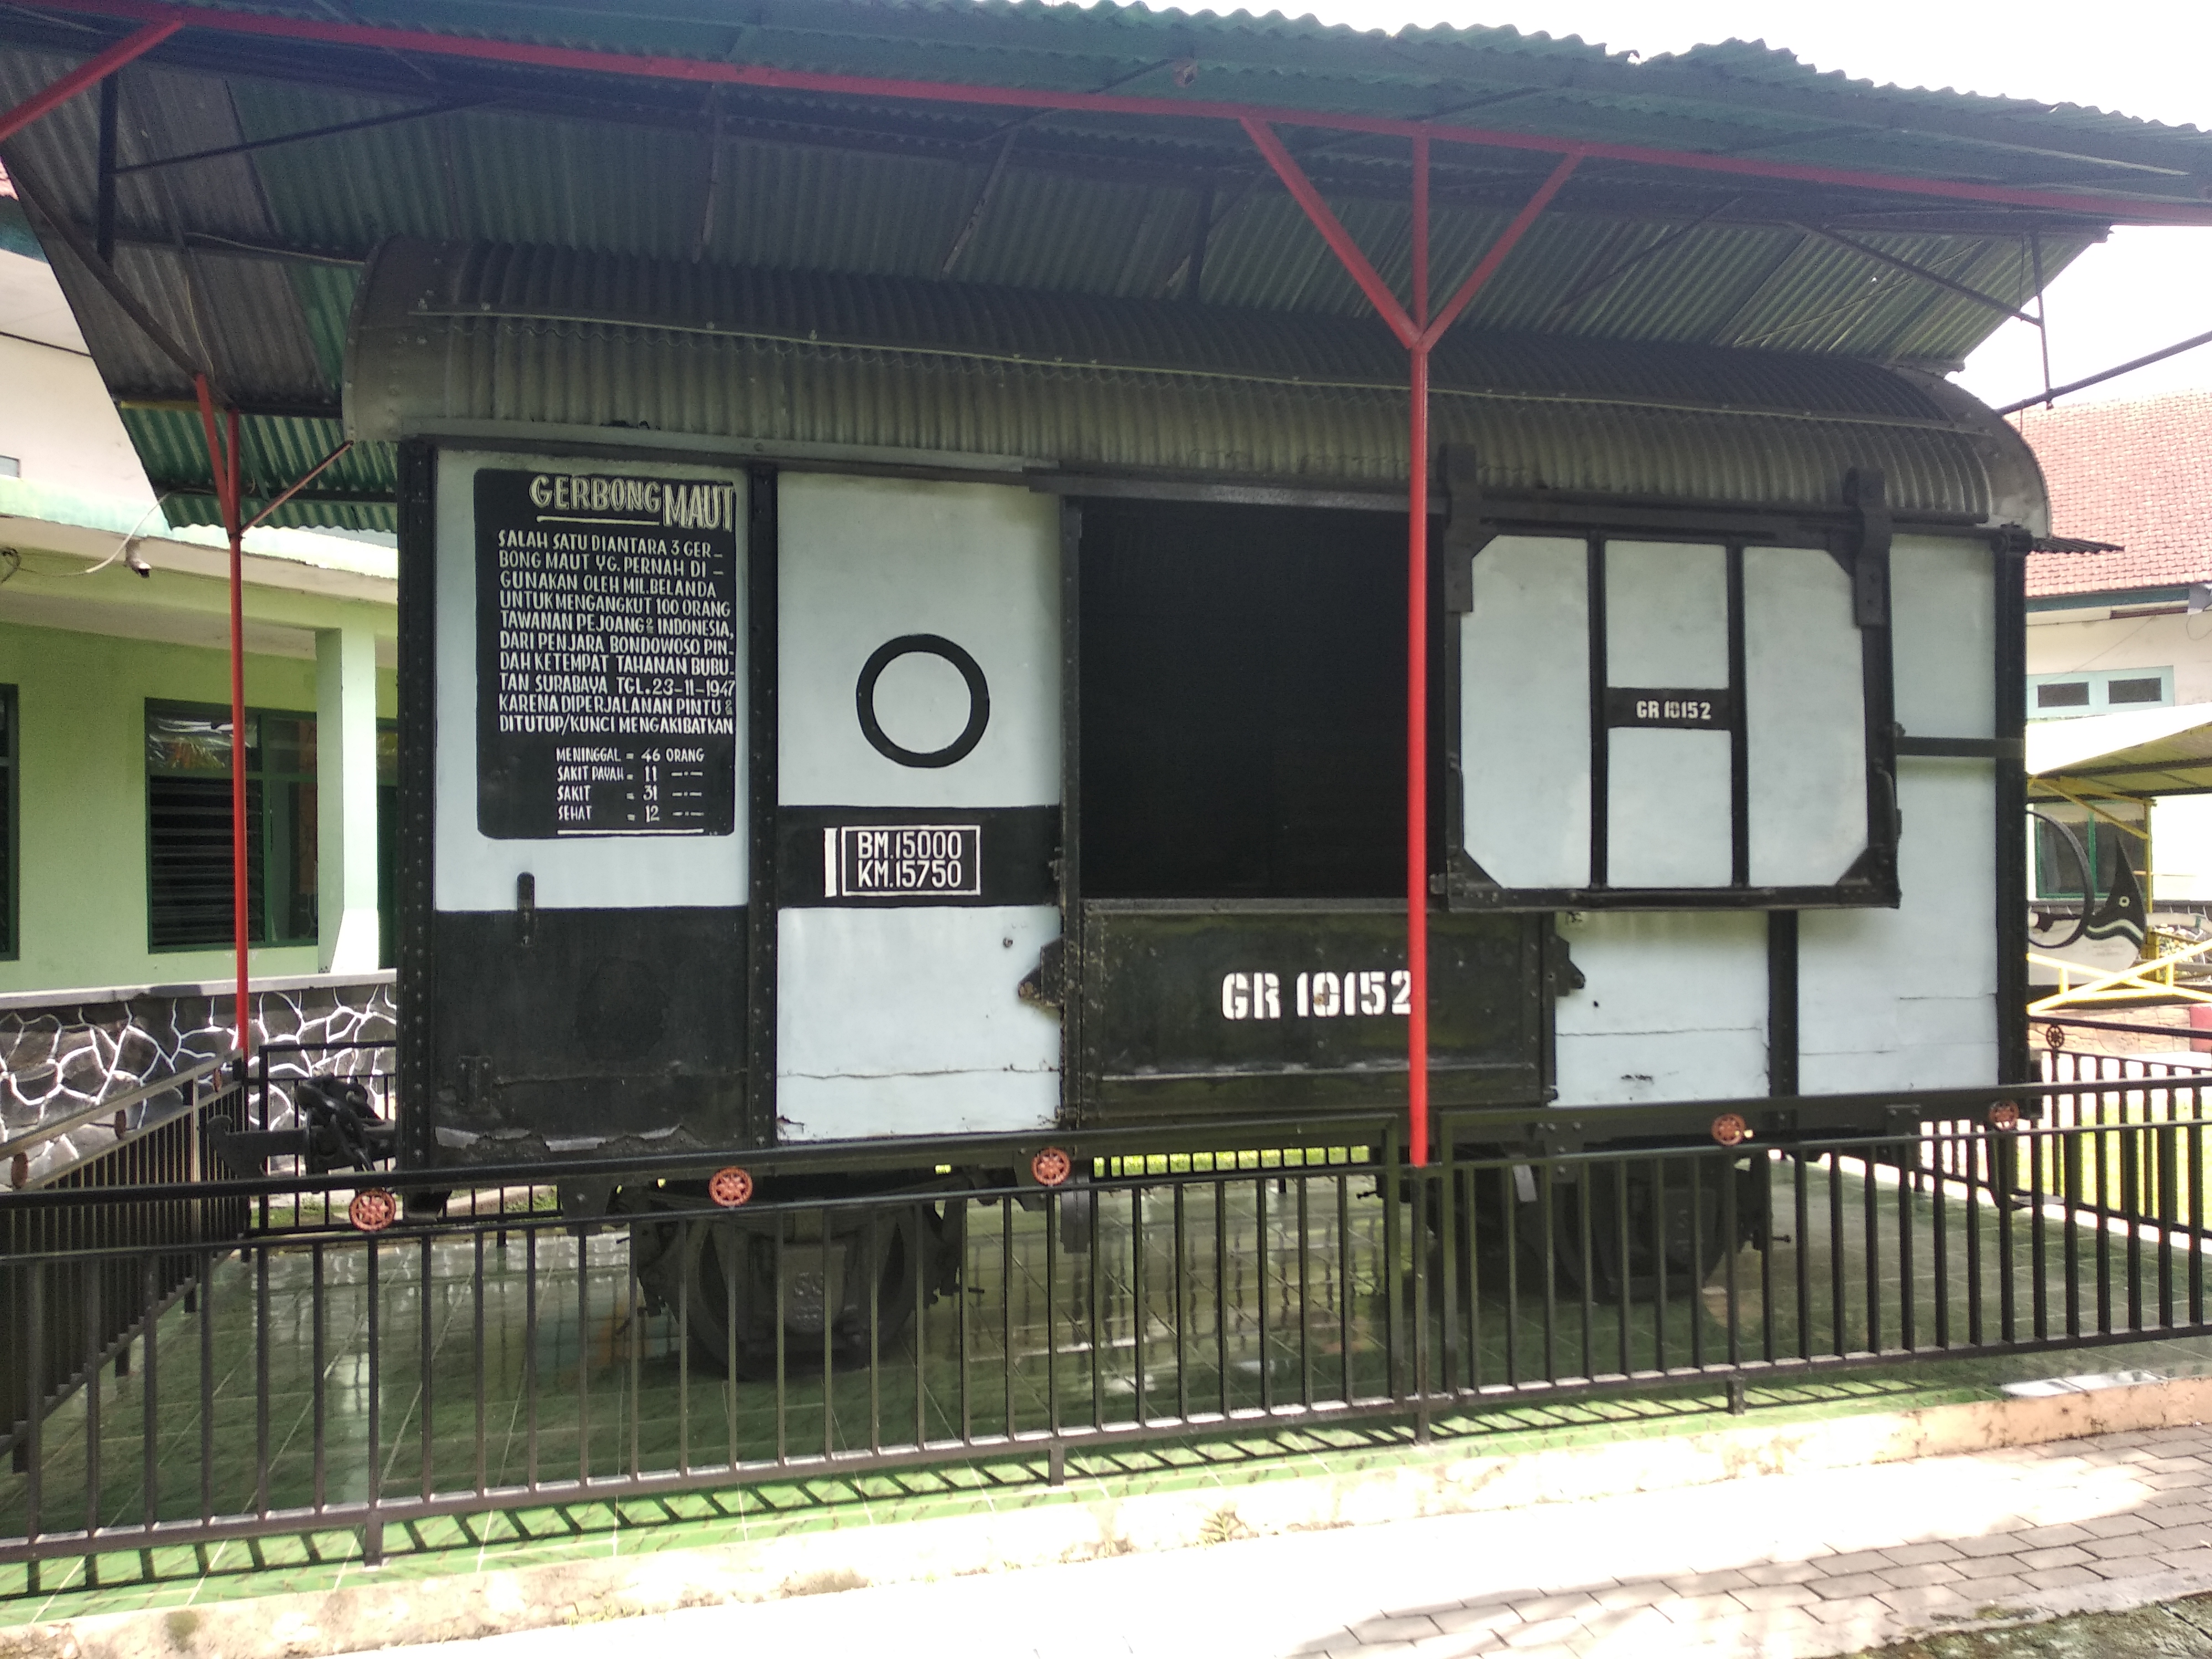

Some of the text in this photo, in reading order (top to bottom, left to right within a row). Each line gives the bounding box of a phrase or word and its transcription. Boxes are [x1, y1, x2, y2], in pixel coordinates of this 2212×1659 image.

[529, 474, 733, 533] GERBONG MAUT
[498, 529, 548, 549] SALAH
[553, 533, 587, 551] SATU
[592, 534, 667, 556] DIANTARA
[671, 539, 680, 556] 3
[499, 550, 541, 569] BONG
[545, 552, 590, 571] MAUT
[596, 554, 620, 572] YG.
[624, 556, 684, 576] PERNAH
[500, 570, 577, 591] GUNAKAN
[583, 574, 619, 594] OLEH
[500, 589, 731, 618] UNTUK MENGANGKUT 100 ORANG
[500, 610, 572, 630] TAWANAN
[658, 617, 734, 640] INDONESIA,
[500, 631, 534, 650] DARI
[538, 633, 604, 653] PENJARA
[610, 635, 701, 655] BONDOWOSO
[500, 651, 530, 670] DAH
[534, 652, 609, 673] KETEMPAT
[616, 655, 687, 675] TAHANAN
[499, 672, 529, 691] TAN
[535, 674, 608, 695] SURABAYA
[499, 693, 559, 713] KARENA
[561, 695, 672, 715] DIPERJALANAN
[676, 698, 721, 716] PINTU
[1636, 700, 1712, 721] GR 10152
[499, 713, 733, 737] DITUTUP/KUNCI MENGAKIBATKAN
[556, 747, 622, 762] MENINGGAL
[641, 748, 661, 763] 46
[665, 748, 705, 762] ORANG
[556, 765, 589, 782] SAKIT
[591, 765, 624, 781] PAYAH
[645, 765, 658, 782] 11
[556, 785, 591, 802] SAKIT
[643, 785, 658, 801] 31
[557, 805, 593, 821] SEHAT
[645, 805, 660, 823] 12
[1221, 969, 1412, 1020] GR 10152
